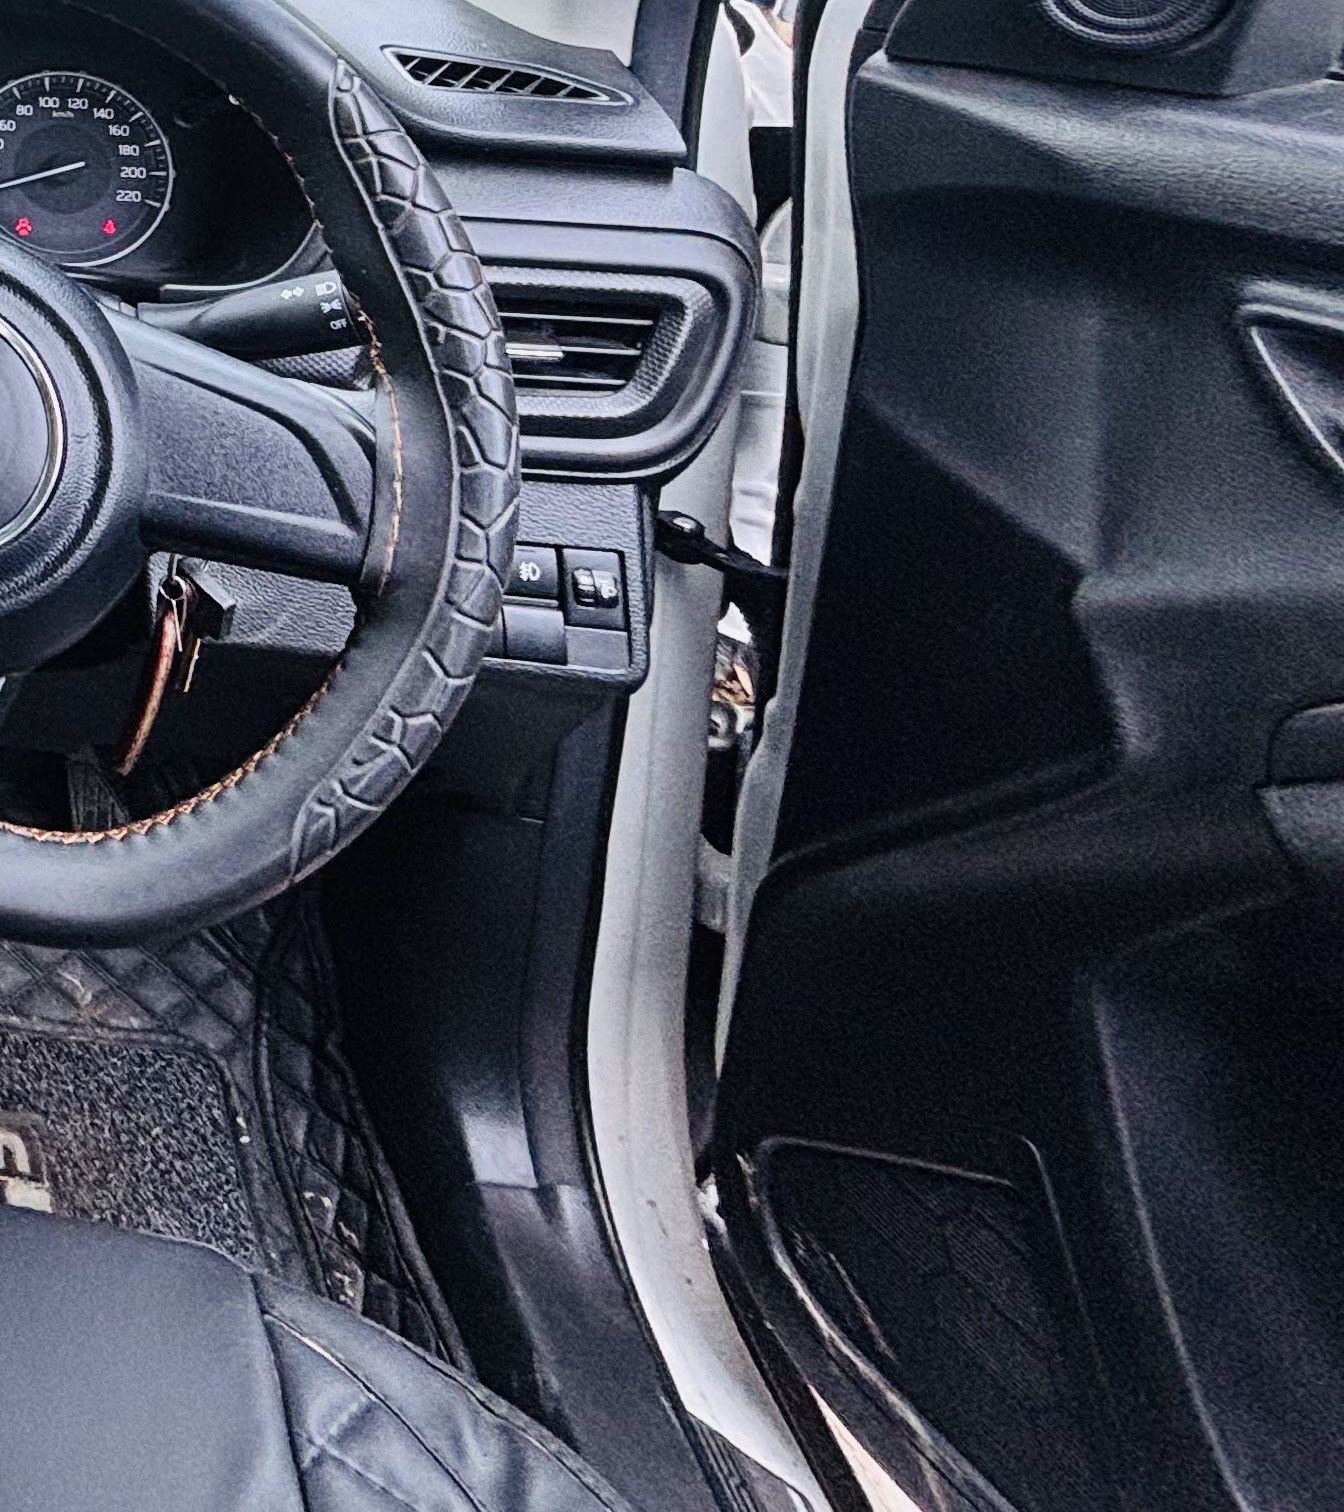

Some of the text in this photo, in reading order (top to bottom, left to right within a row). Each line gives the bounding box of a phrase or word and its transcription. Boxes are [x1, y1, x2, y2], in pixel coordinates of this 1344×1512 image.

[38, 96, 60, 109] 100
[67, 97, 89, 110] 120
[15, 104, 34, 116] 80
[92, 108, 114, 120] 140
[108, 124, 130, 137] 160
[118, 144, 140, 157] 180
[119, 166, 147, 179] 200
[116, 190, 142, 203] 220
[330, 318, 348, 330] OFF
